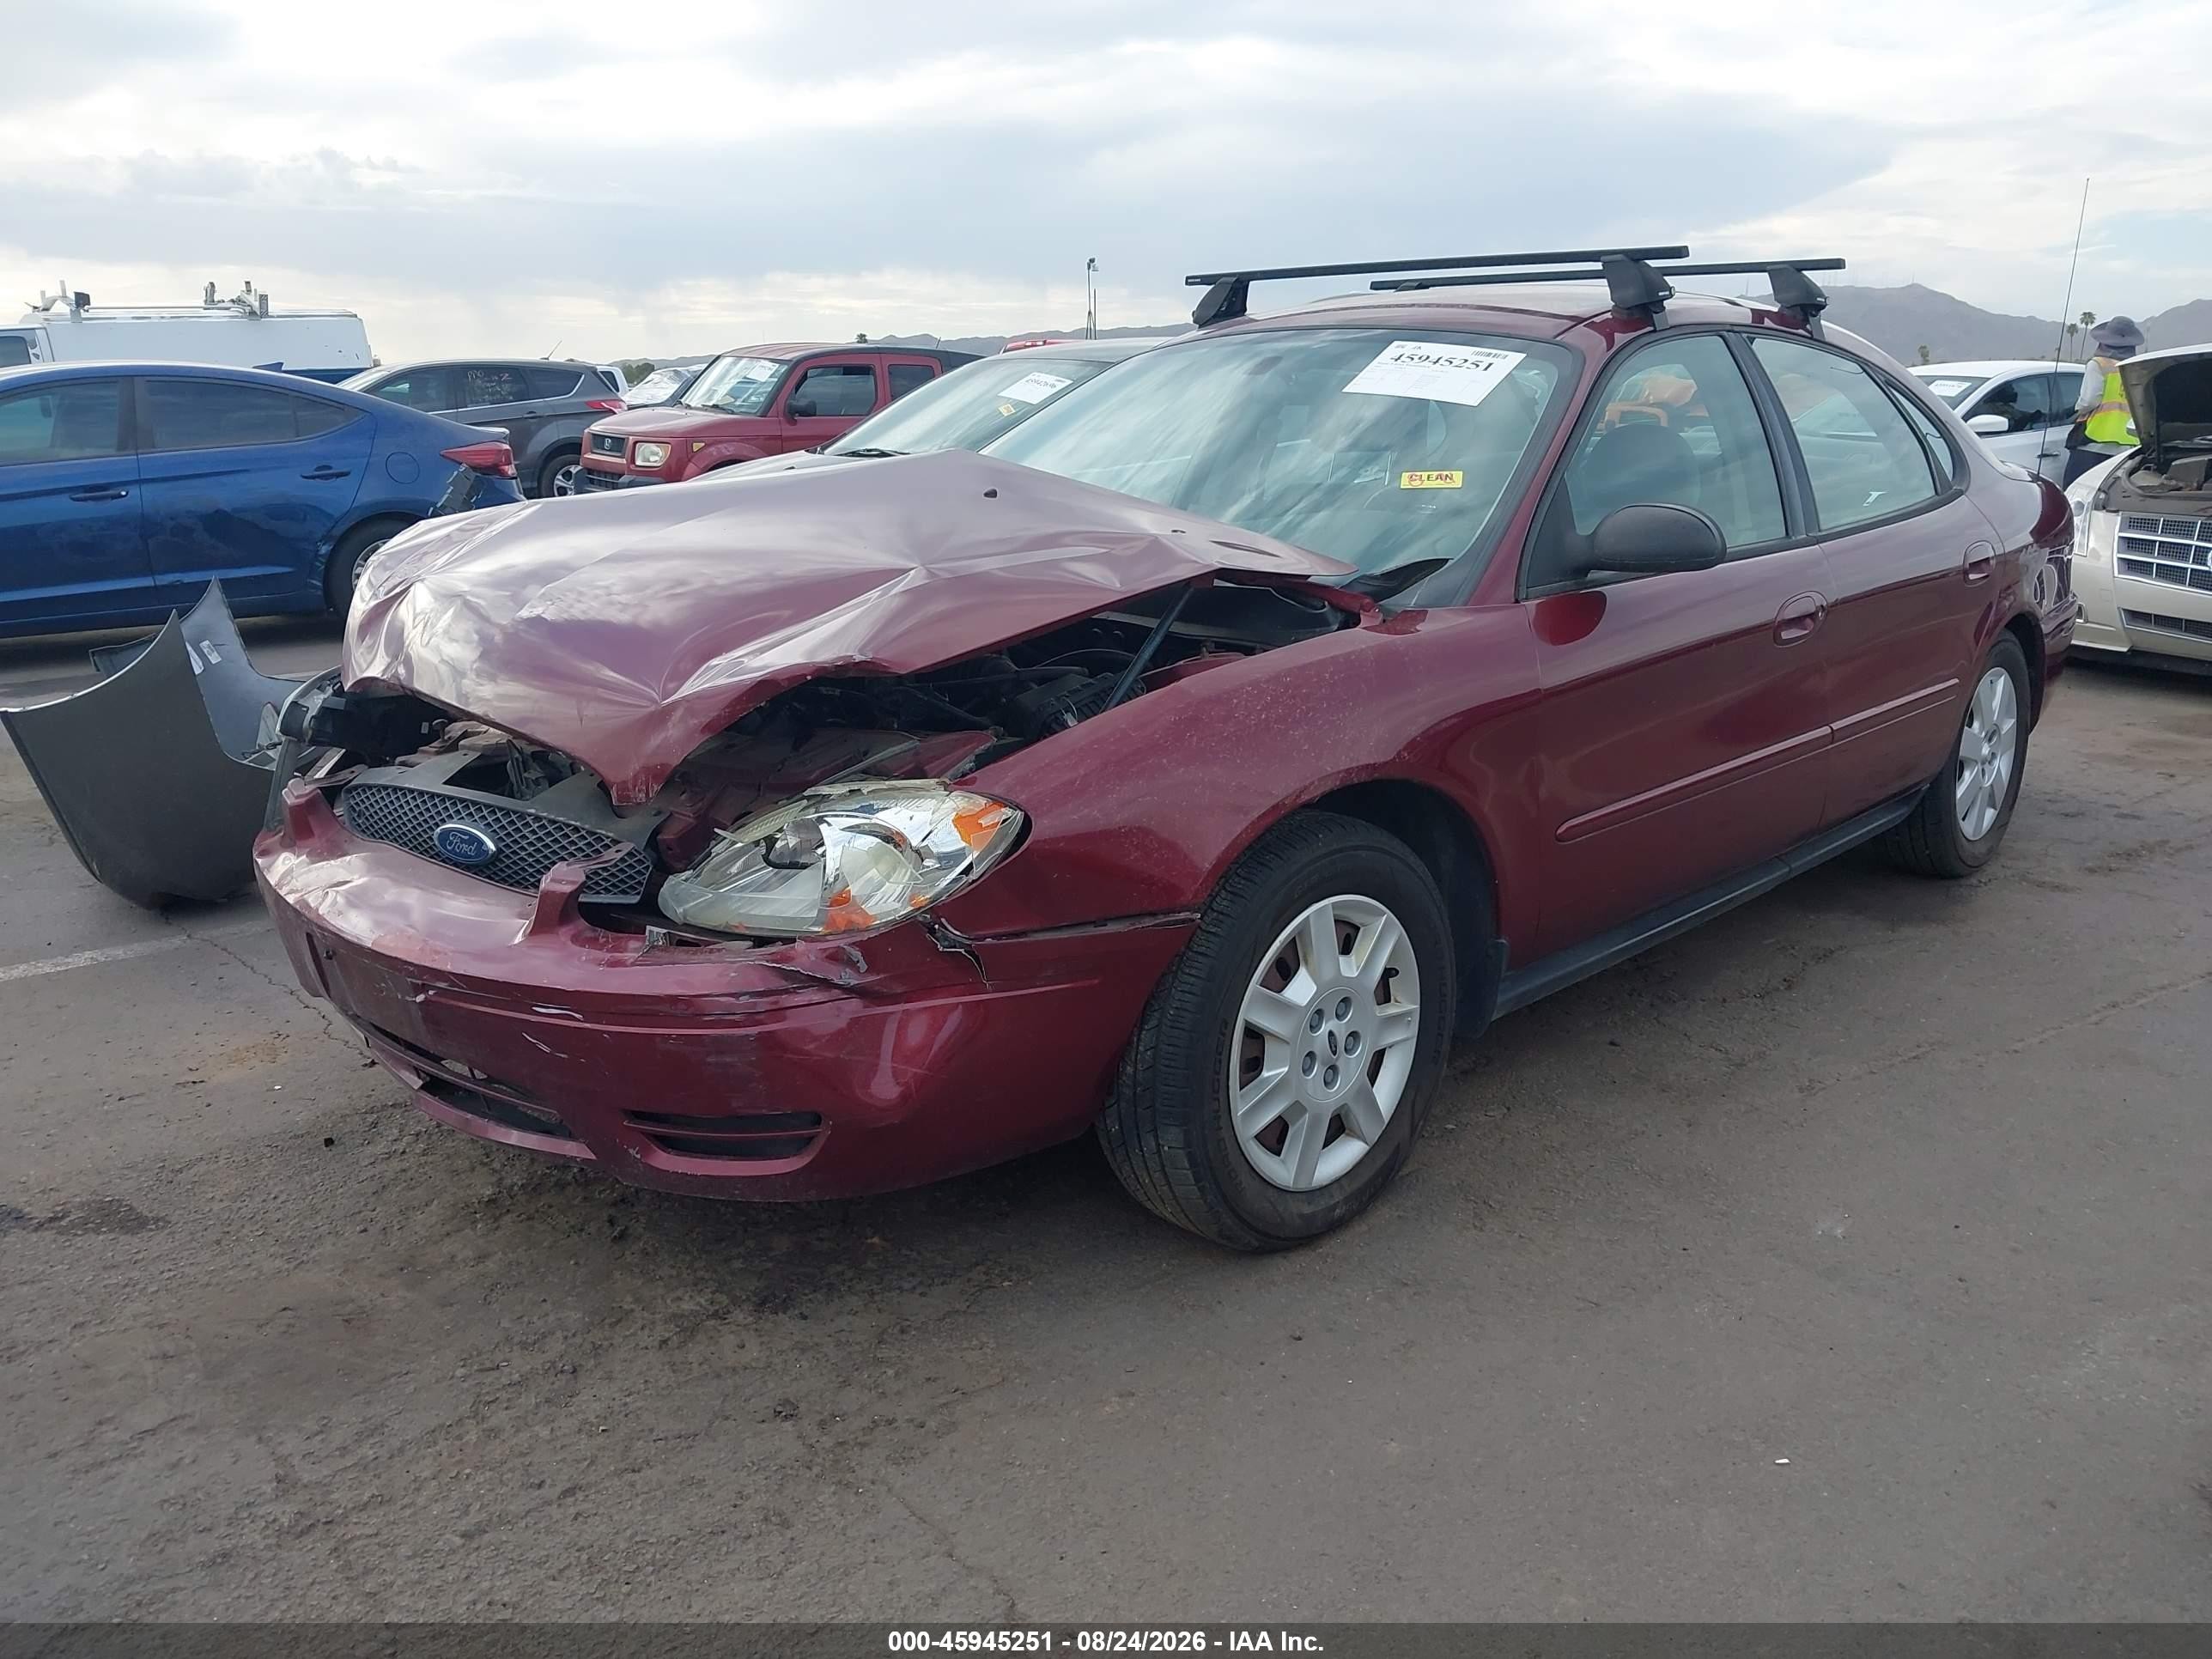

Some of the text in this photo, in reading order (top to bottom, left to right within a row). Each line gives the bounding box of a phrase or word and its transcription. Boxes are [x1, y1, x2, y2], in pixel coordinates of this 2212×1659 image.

[1389, 353, 1494, 372] 45945251
[1409, 472, 1454, 482] CLEAN
[447, 831, 478, 856] Ford
